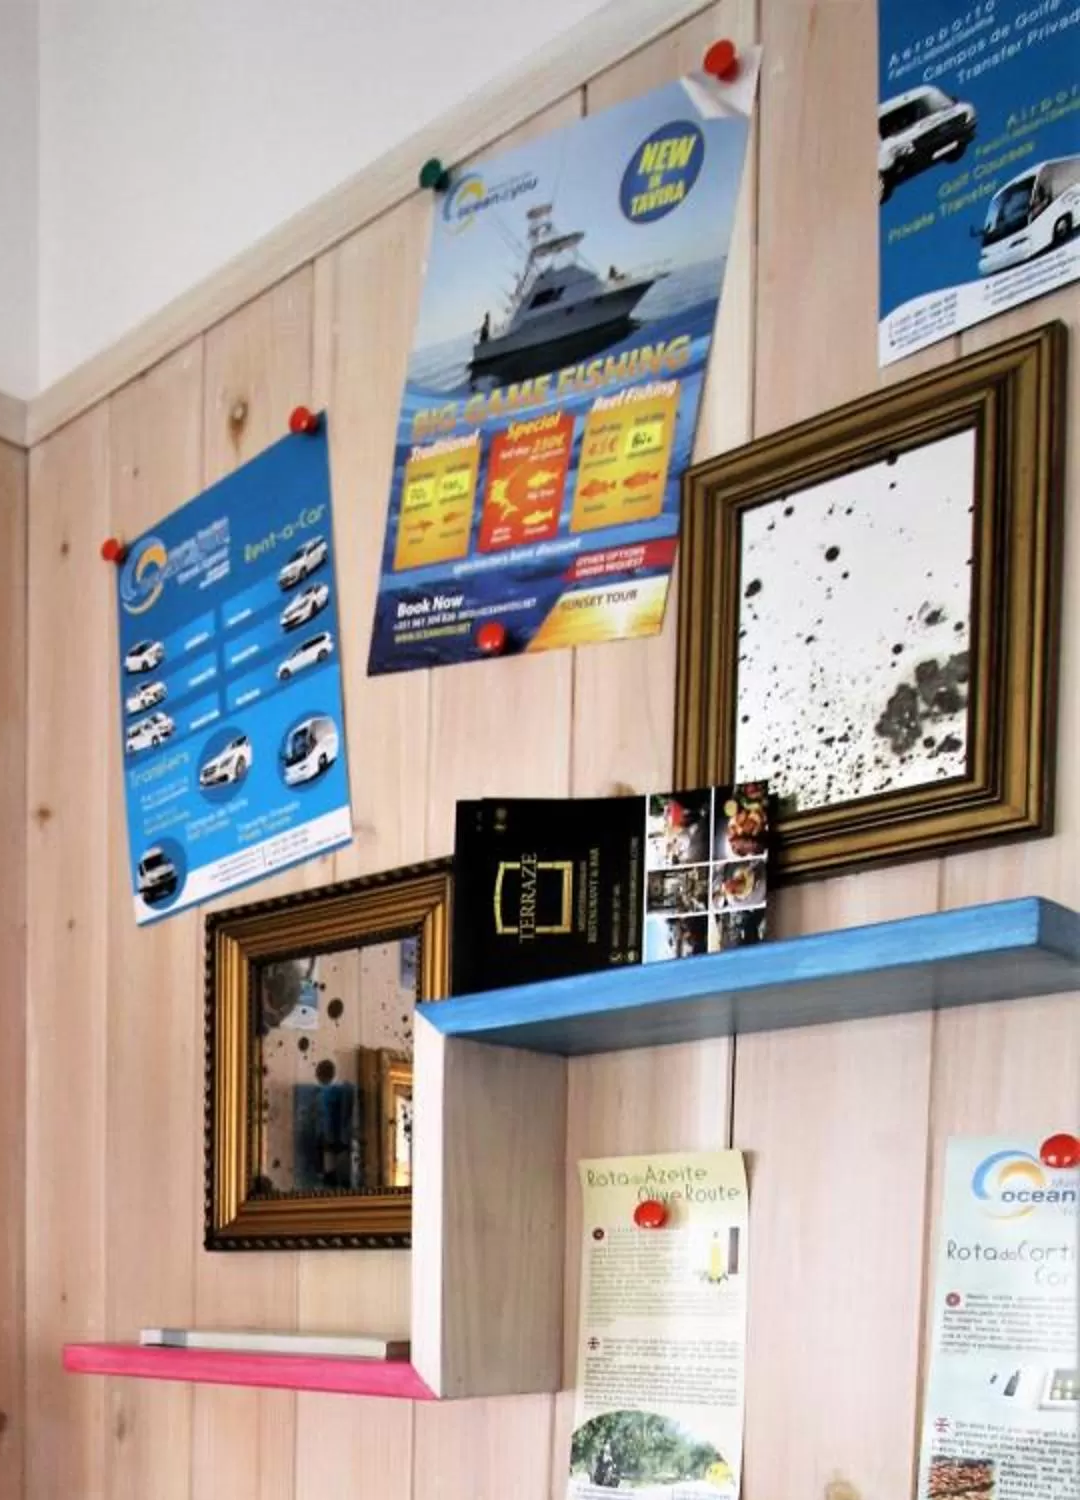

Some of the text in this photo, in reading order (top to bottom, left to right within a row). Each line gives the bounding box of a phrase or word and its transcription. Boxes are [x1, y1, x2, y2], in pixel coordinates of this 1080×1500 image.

[637, 133, 697, 176] NEW
[411, 333, 694, 447] BIG GAME FISHING
[397, 594, 465, 618] Book Now
[519, 851, 539, 944] TERRAZE
